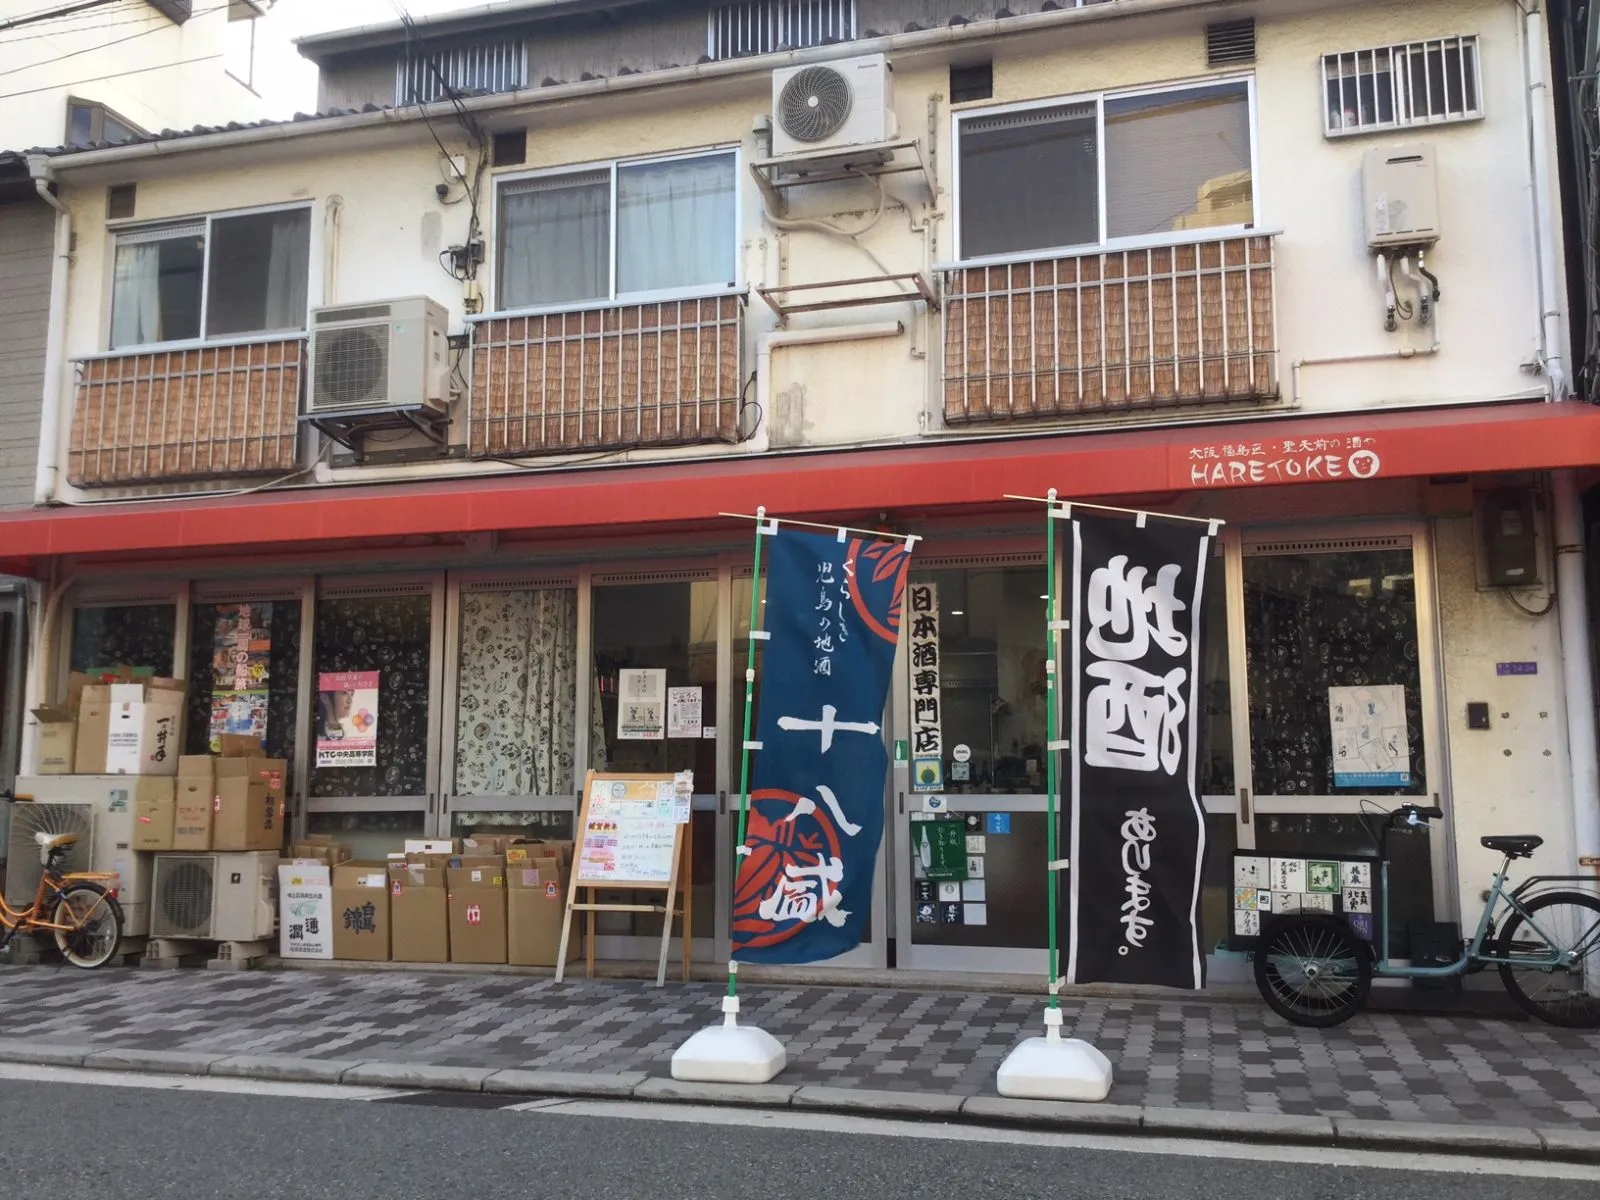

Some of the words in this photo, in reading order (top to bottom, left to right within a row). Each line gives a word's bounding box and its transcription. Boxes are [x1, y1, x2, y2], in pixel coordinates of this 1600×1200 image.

[1191, 454, 1343, 486] HARETOKE
[813, 561, 836, 677] 児島の地酒
[910, 586, 943, 754] 日本酒専門店
